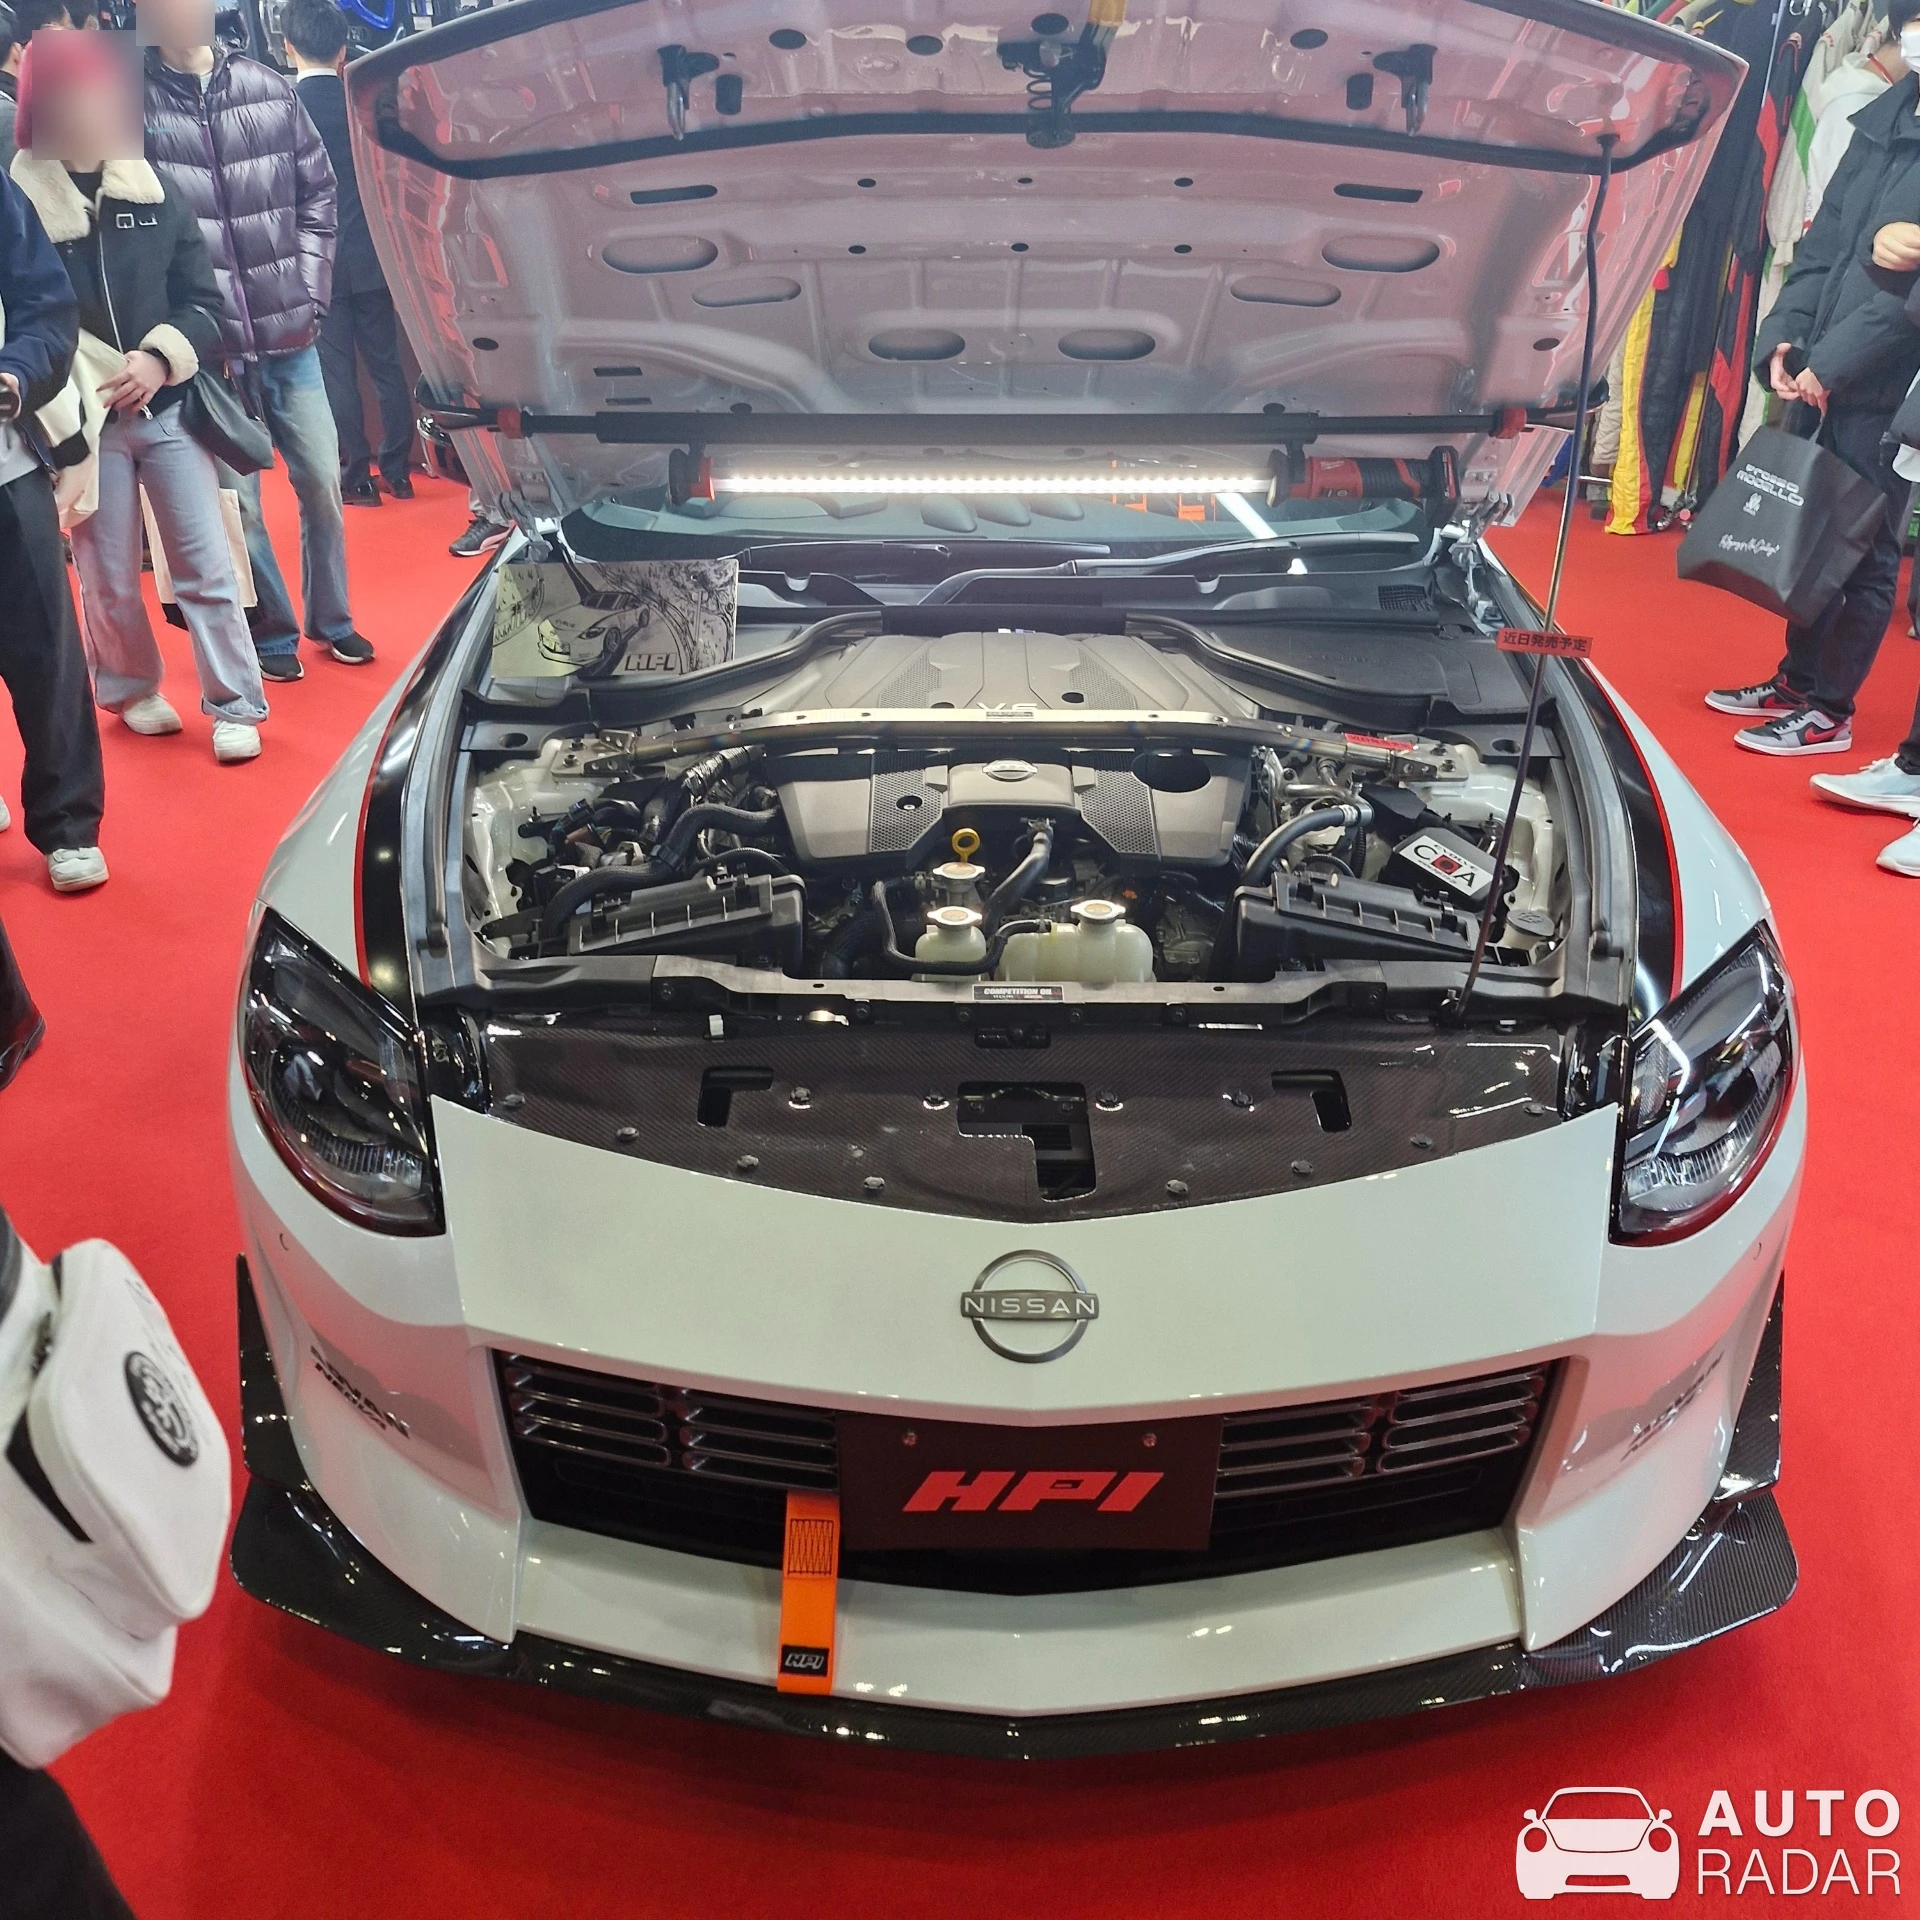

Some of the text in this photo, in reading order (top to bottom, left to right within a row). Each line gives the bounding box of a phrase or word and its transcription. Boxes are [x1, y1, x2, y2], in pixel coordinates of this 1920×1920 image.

[1504, 631, 1588, 652] 近日発売予定
[624, 652, 678, 671] HPI
[983, 987, 1039, 995] COMPETITION
[964, 1297, 1095, 1314] NISSAN
[315, 1362, 387, 1430] NEOVA
[902, 1471, 1164, 1512] HPI
[785, 1653, 825, 1670] HPI
